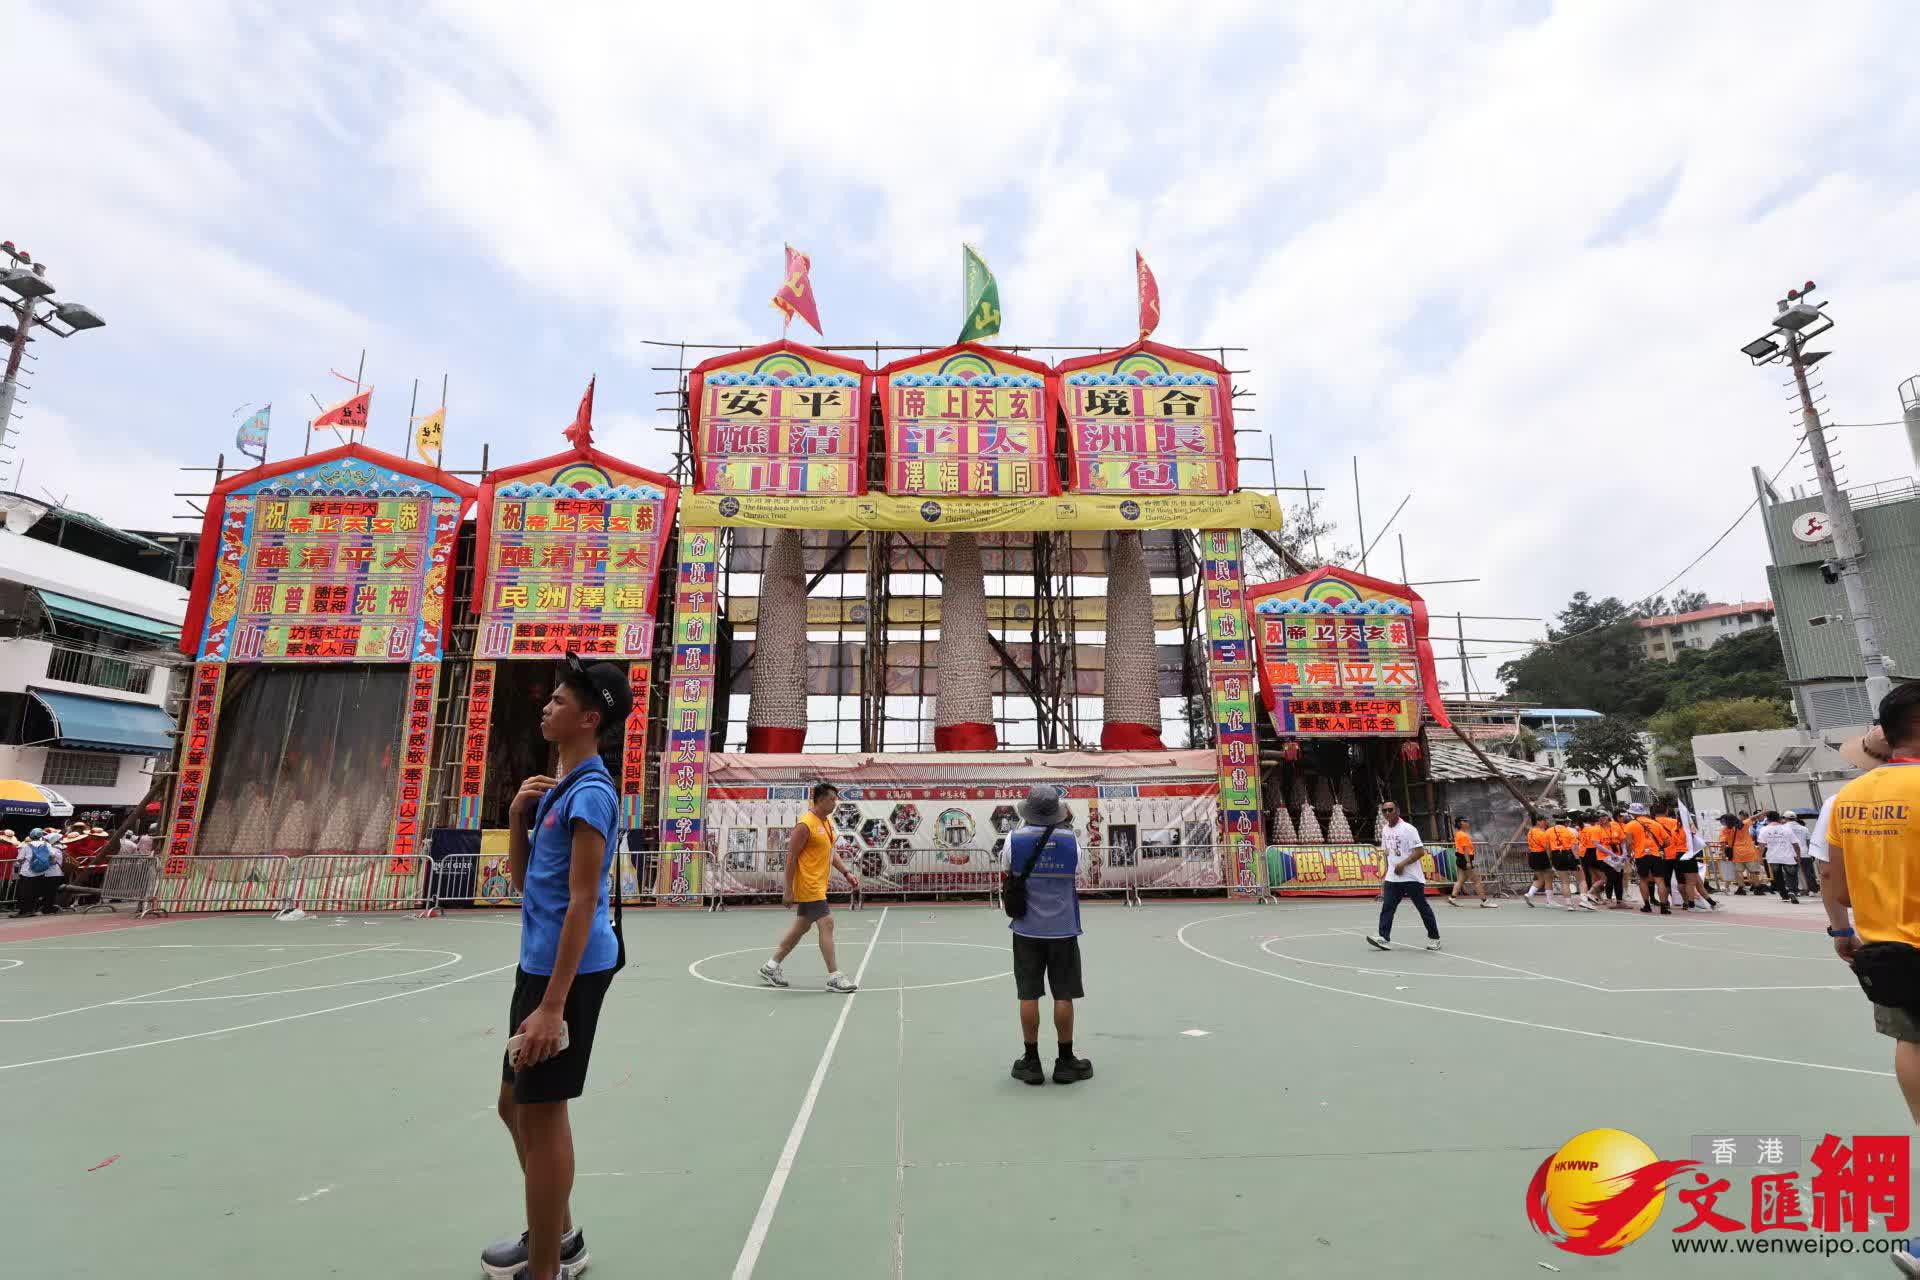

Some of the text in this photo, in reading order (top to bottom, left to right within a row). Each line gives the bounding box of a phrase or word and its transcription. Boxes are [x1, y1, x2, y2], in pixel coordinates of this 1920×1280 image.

[721, 390, 842, 416] 平安
[906, 389, 1029, 418] 玄天上帝
[1085, 390, 1201, 415] 合境
[716, 425, 841, 454] 清醮
[905, 425, 1029, 454] 太平
[1085, 424, 1206, 454] 長洲
[749, 461, 803, 491] 山
[905, 461, 1031, 492] 同沾福澤
[1122, 460, 1176, 490] 包
[288, 517, 396, 533] 玄天上帝
[525, 516, 631, 531] 玄天上帝
[256, 547, 417, 569] 太平清醮
[501, 546, 648, 568] 太平清醮
[498, 586, 644, 608] 福澤洲民
[234, 625, 409, 658] 包 山
[484, 622, 644, 655] 包 山
[1265, 662, 1416, 685] 太平清醮
